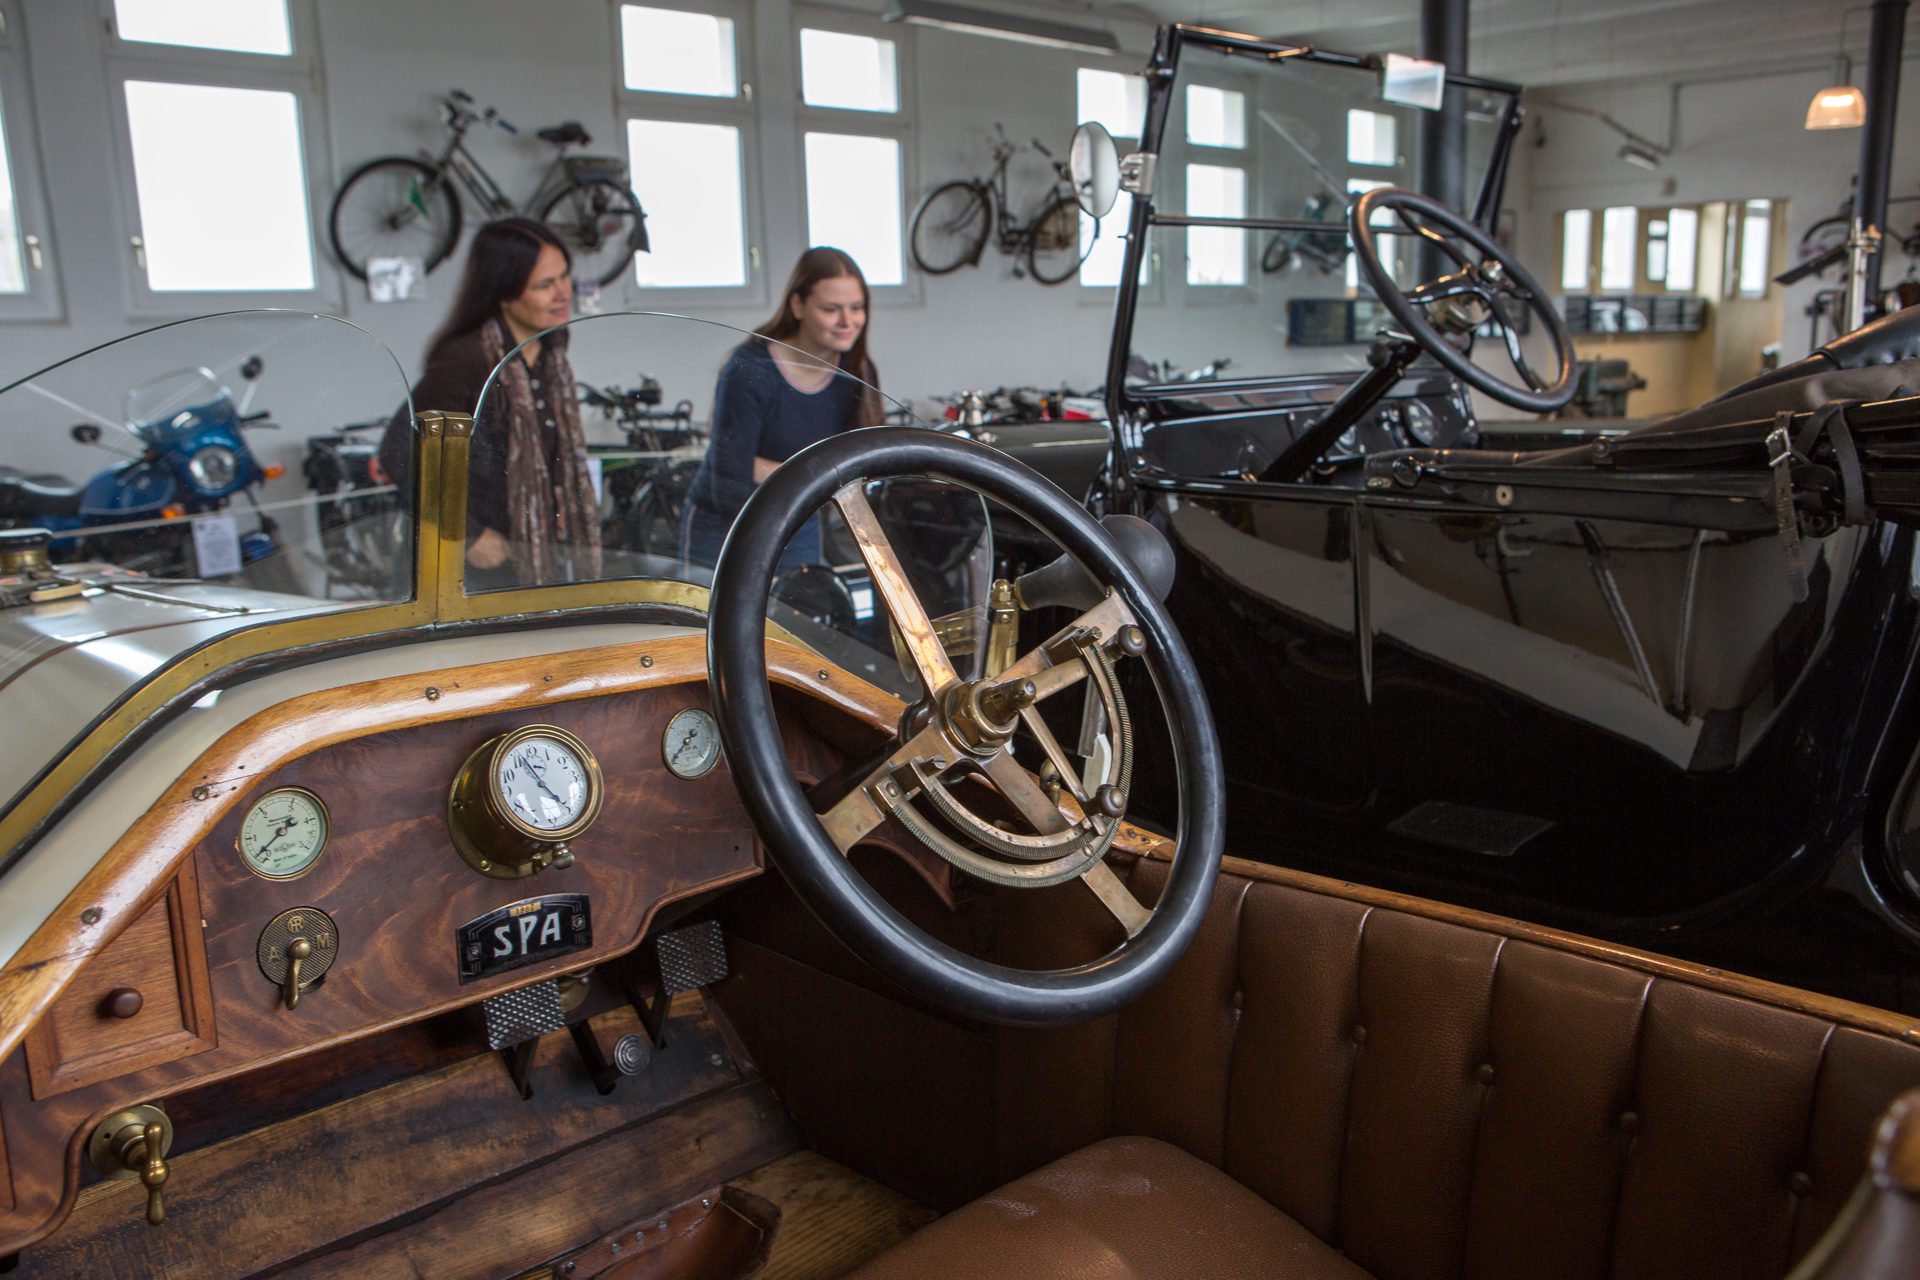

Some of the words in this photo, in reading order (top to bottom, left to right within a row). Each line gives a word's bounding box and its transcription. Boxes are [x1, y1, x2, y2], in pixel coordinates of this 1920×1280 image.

[545, 747, 550, 761] 1
[557, 756, 568, 769] 2
[503, 768, 515, 783] 10
[568, 770, 578, 783] 3
[514, 799, 525, 813] 8
[494, 912, 561, 957] SPA
[316, 933, 330, 951] M
[268, 946, 281, 963] A
